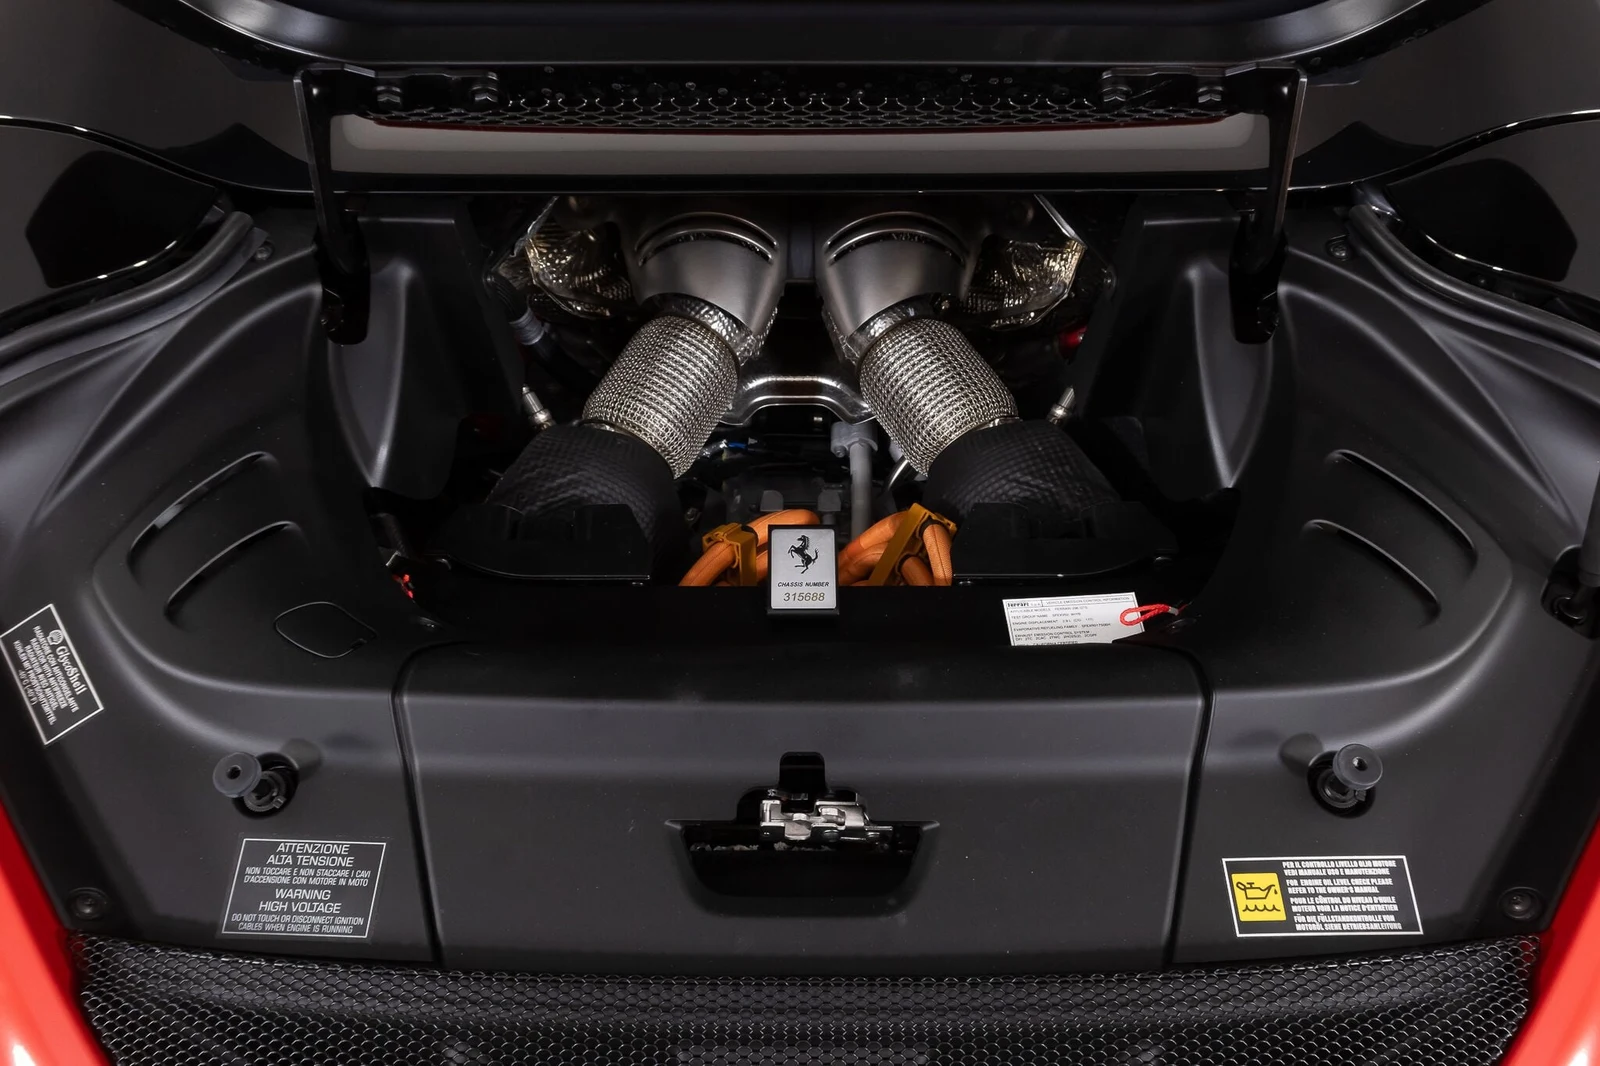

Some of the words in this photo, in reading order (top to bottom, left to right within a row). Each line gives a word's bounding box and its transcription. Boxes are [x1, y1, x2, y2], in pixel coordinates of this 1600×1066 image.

[784, 593, 825, 601] 315688
[56, 646, 87, 695] GlycoShell
[276, 843, 350, 855] ATTENZIONE
[266, 855, 293, 865] ALTA
[297, 856, 354, 867] TENSIONE
[263, 867, 291, 875] TOCCARE
[300, 868, 314, 876] NON
[316, 869, 350, 877] STACCARE
[355, 870, 371, 878] CAVI
[244, 876, 291, 884] D'ACCENSIONE
[348, 879, 368, 887] MOTO
[275, 889, 331, 900] WARNING
[259, 901, 288, 912] HIGH
[291, 902, 342, 913] VOLTAGE
[243, 914, 256, 922] NOT
[258, 914, 279, 922] TOUCH
[292, 915, 333, 924] DISCONNECT
[334, 917, 364, 925] IGNITION
[1294, 914, 1306, 922] FÜR
[265, 923, 285, 931] WHEN
[287, 924, 311, 932] ENGINE
[322, 925, 353, 933] RUNNING
